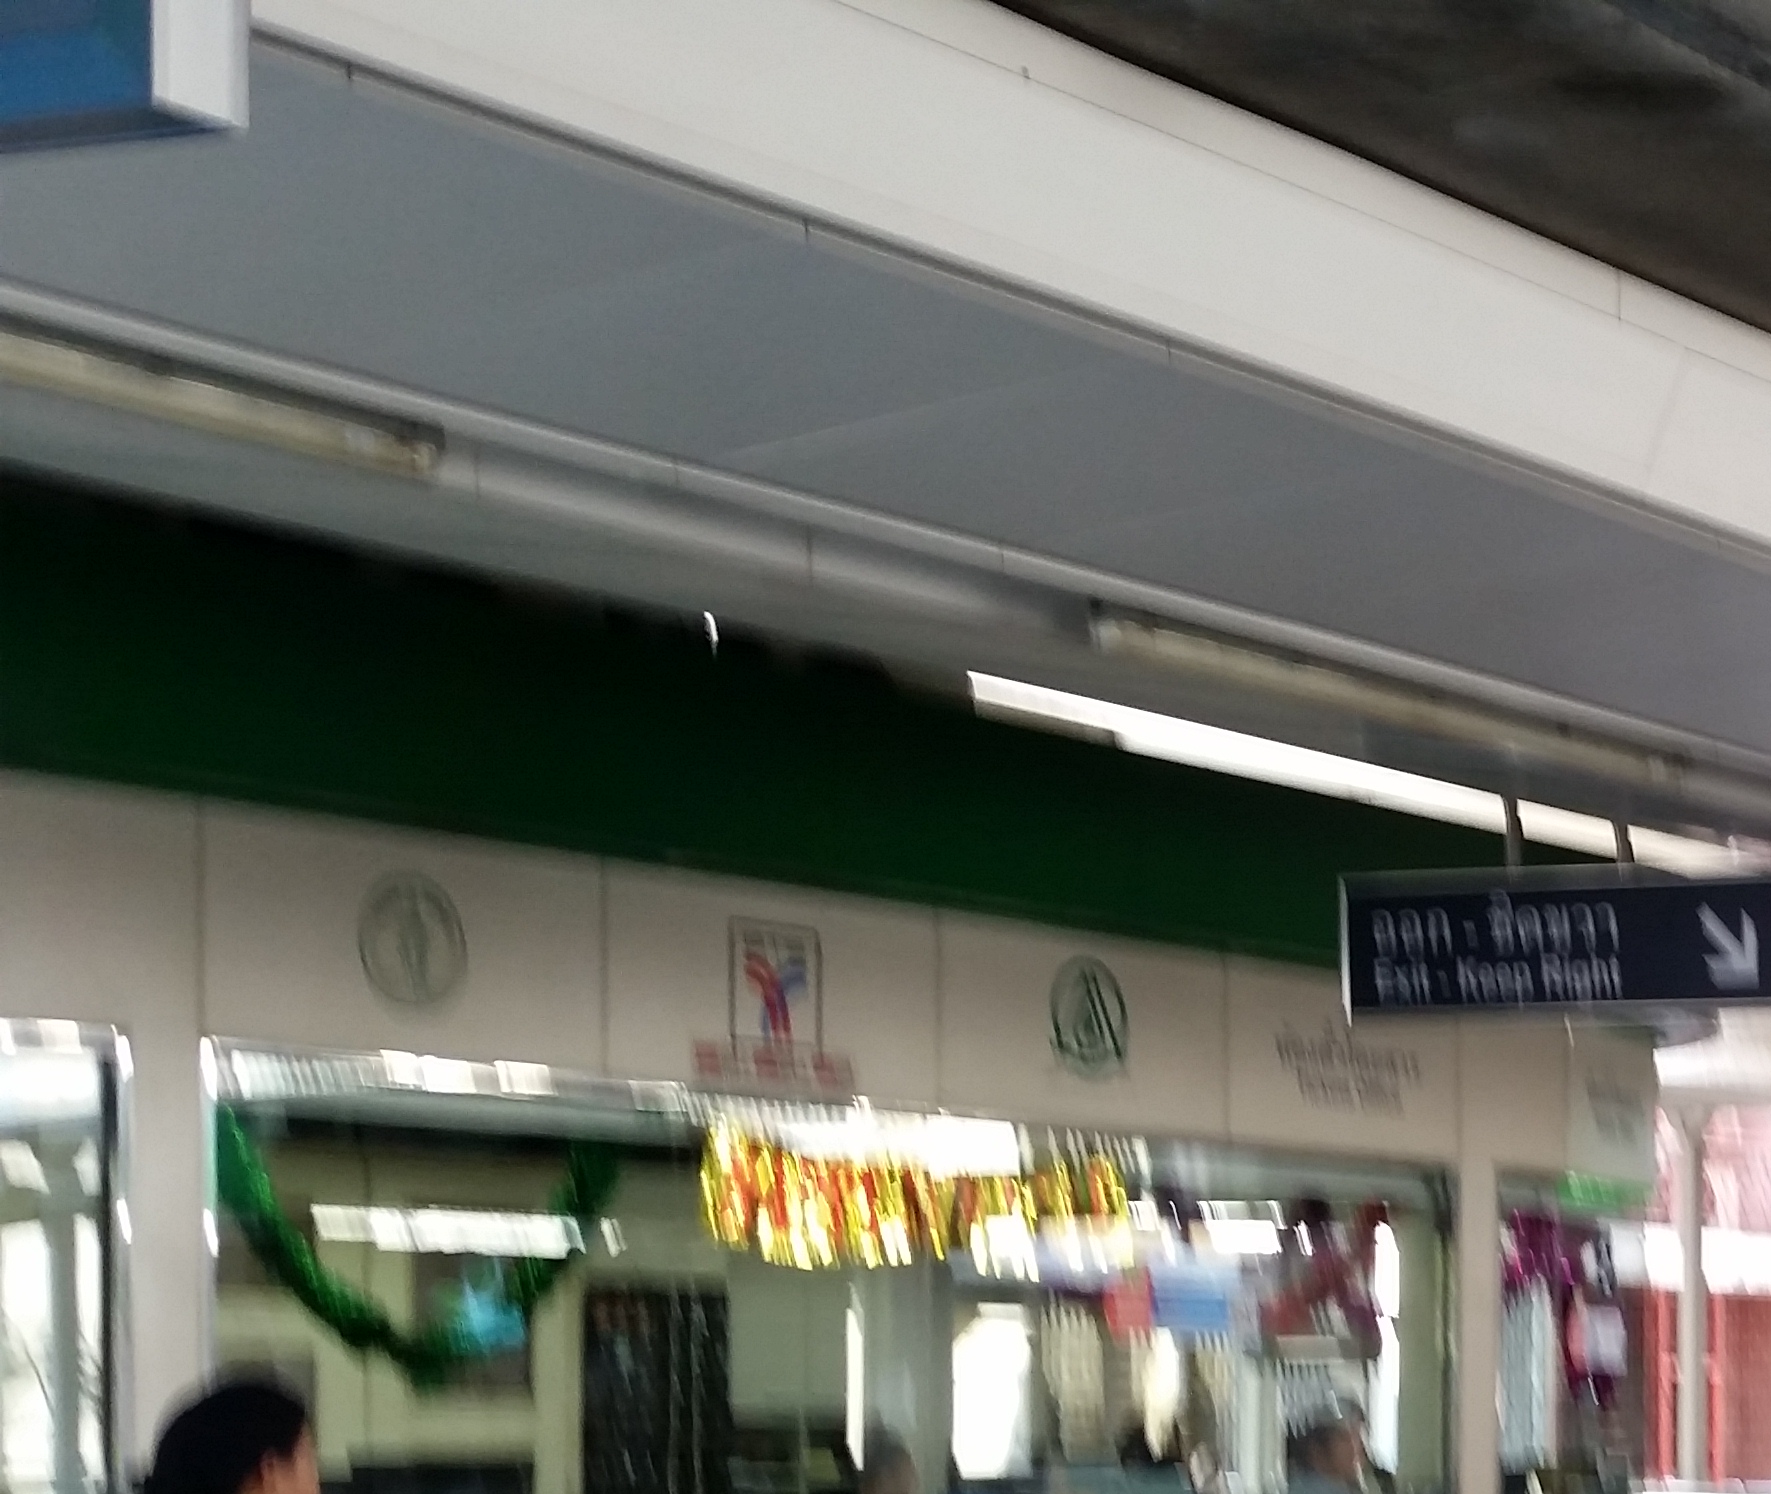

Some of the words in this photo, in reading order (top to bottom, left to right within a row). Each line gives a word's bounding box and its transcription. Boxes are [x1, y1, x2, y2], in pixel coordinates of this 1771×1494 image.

[1373, 957, 1431, 1006] Exit
[1456, 956, 1535, 1007] Keep
[1541, 953, 1623, 1004] Right
